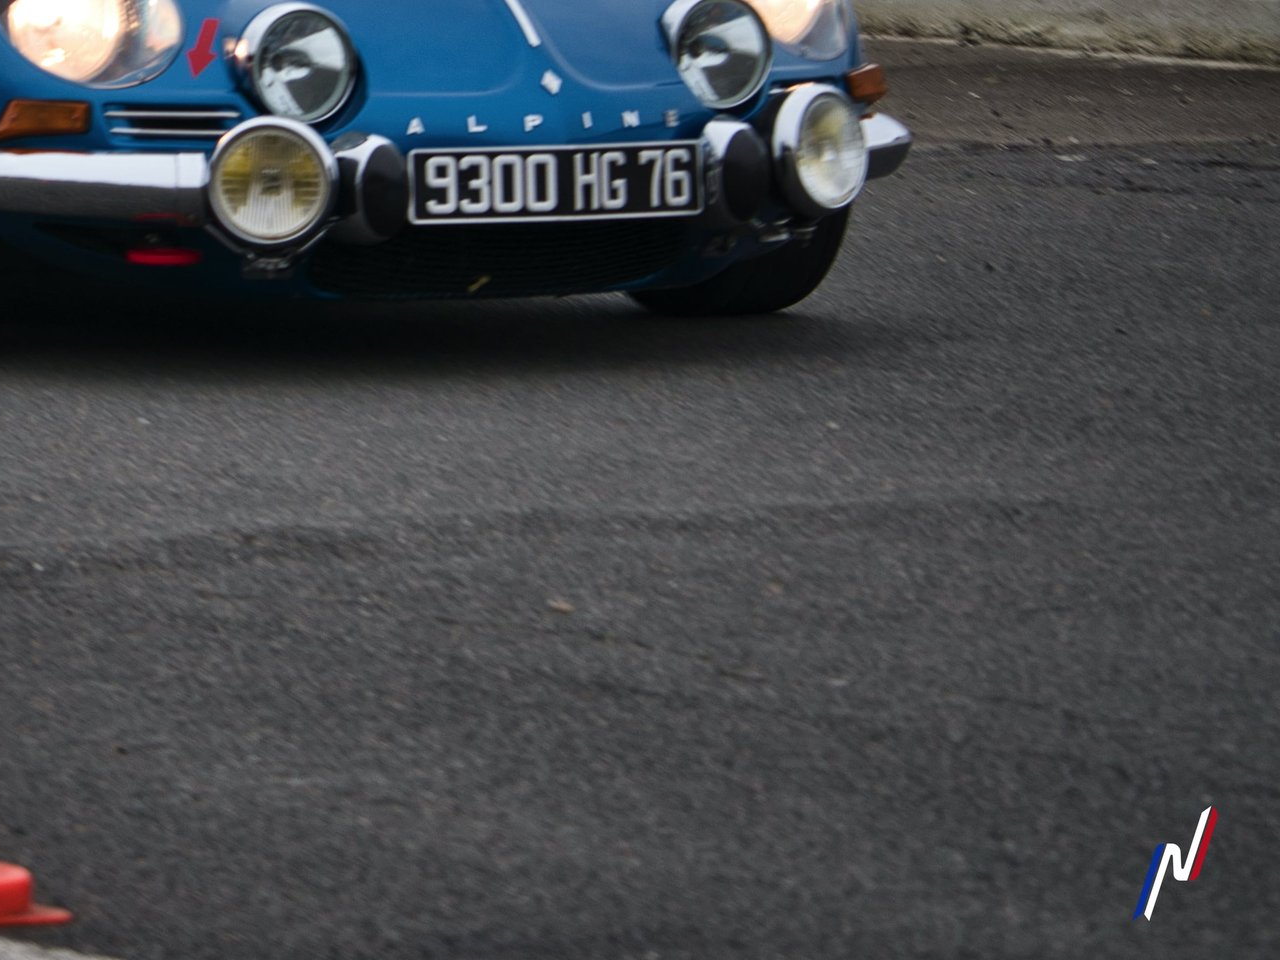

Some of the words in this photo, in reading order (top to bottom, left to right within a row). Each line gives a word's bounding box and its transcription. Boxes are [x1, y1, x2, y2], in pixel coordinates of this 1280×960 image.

[406, 110, 680, 135] ALPINE
[425, 154, 558, 215] 9300
[573, 151, 628, 211] HG
[637, 148, 691, 208] 76
